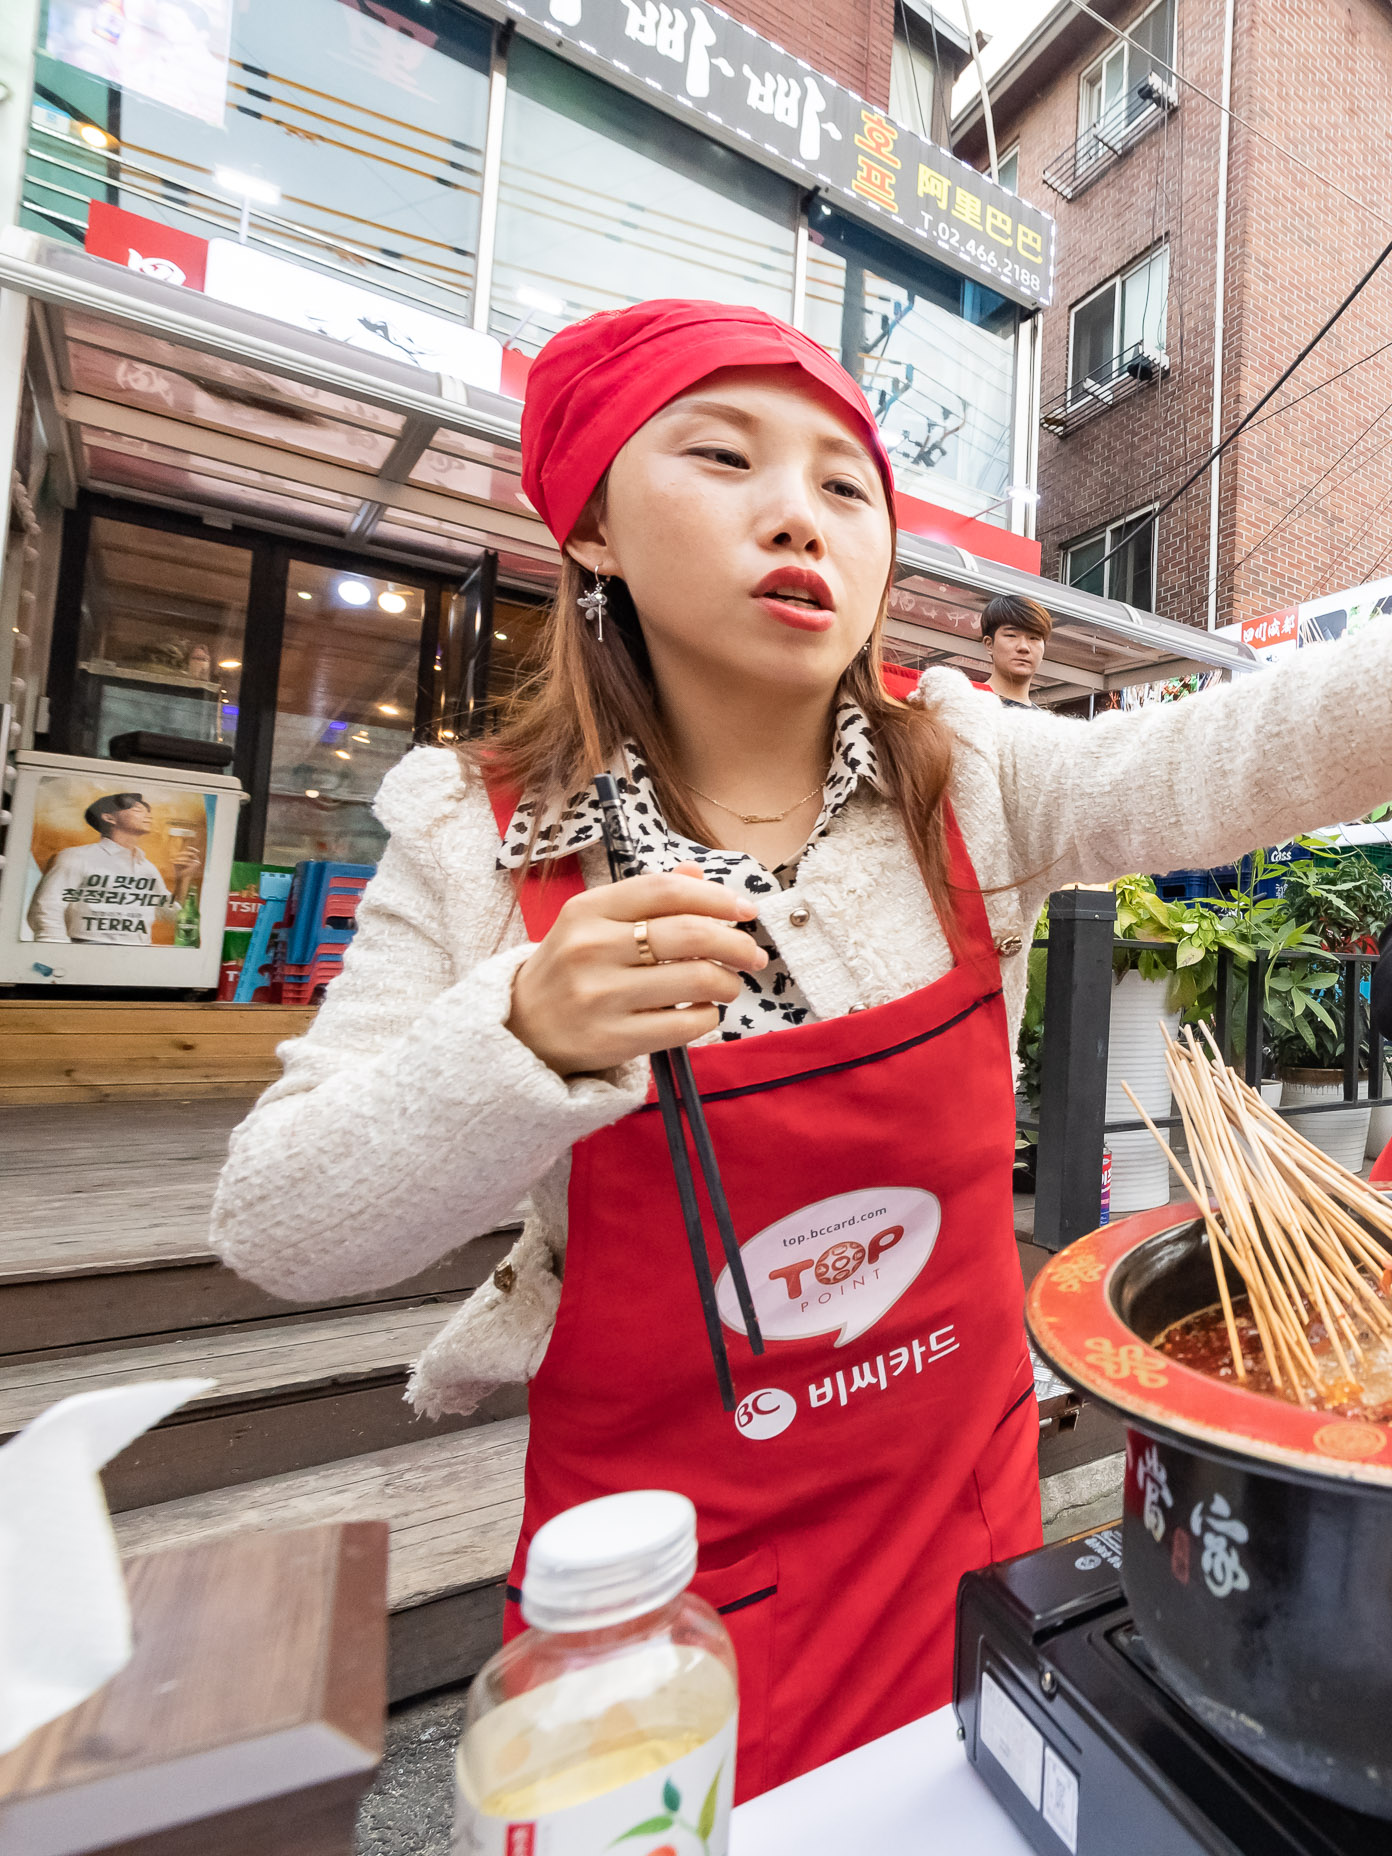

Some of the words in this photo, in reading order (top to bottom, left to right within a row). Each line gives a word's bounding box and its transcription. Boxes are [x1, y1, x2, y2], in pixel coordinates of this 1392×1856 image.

[549, 0, 843, 161] 빠빠
[852, 109, 902, 214] 호프
[917, 163, 1043, 264] 阿里巴巴
[920, 210, 1041, 292] T.02.466.2188
[61, 888, 176, 908] 청정라거다!
[87, 874, 111, 887] 이
[112, 876, 157, 890] 맛이
[82, 916, 148, 934] TERRA
[769, 1225, 904, 1300] TOP
[783, 1206, 887, 1247] top.bccard.com
[801, 1268, 881, 1313] POINT
[736, 1391, 780, 1428] BC
[808, 1324, 960, 1408] 비씨카드
